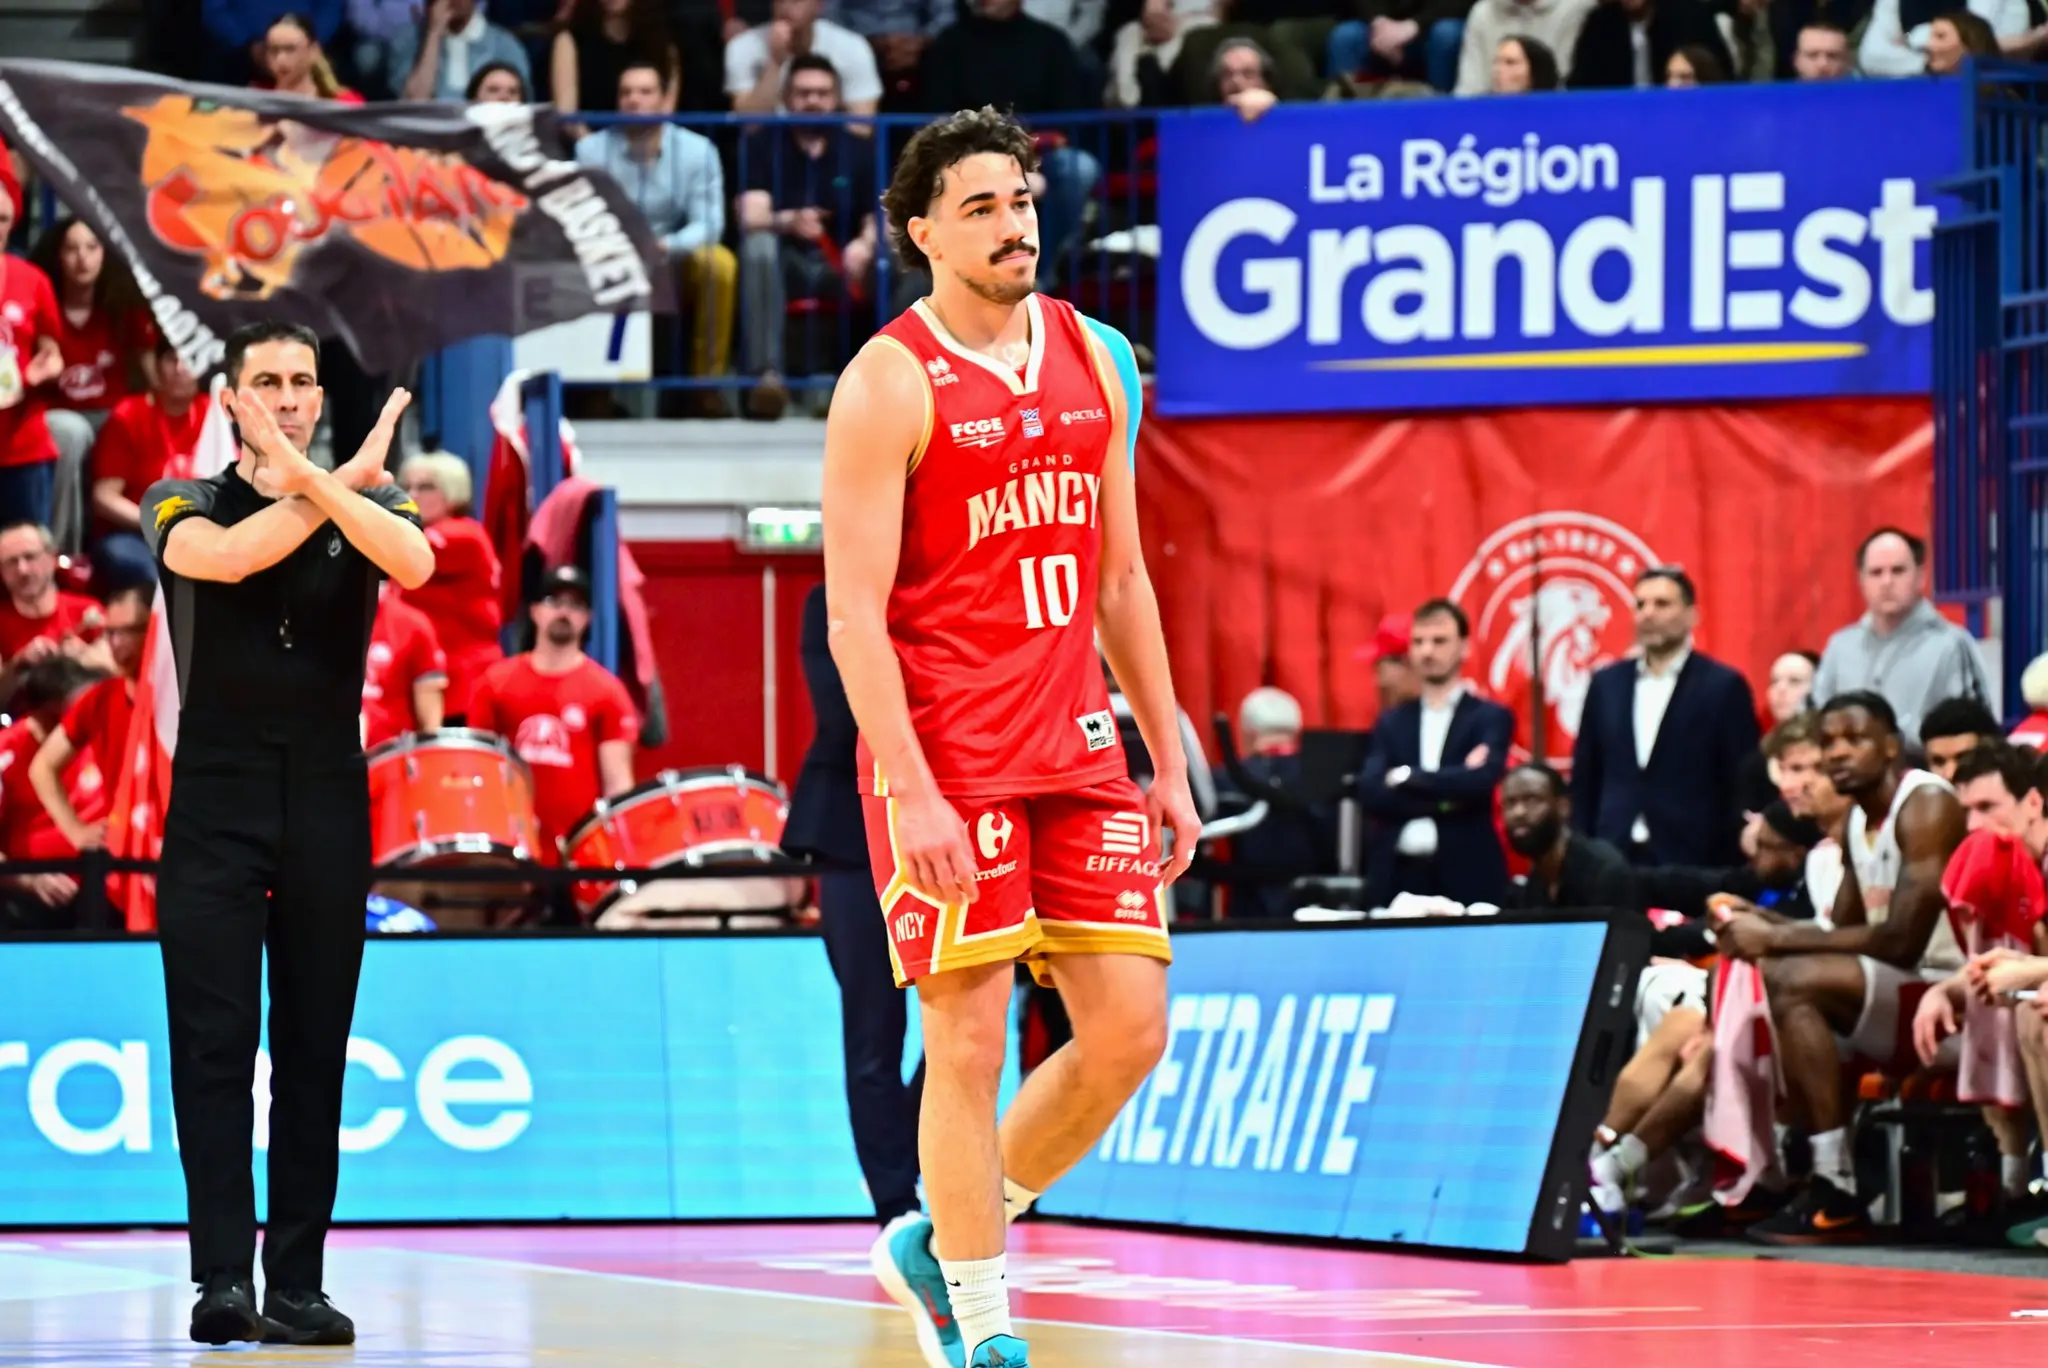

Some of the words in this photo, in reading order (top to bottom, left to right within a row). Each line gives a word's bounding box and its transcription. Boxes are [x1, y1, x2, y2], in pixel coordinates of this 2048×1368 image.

[1309, 143, 1384, 202] La
[1401, 132, 1619, 206] Région
[1180, 175, 1666, 350] Grand
[1690, 171, 1938, 332] Est
[950, 416, 1005, 438] FCGE
[1008, 453, 1074, 474] GRAND
[965, 470, 1102, 552] NANCY
[1017, 553, 1080, 630] 10
[971, 859, 1018, 882] rrefour
[894, 911, 926, 943] NCY
